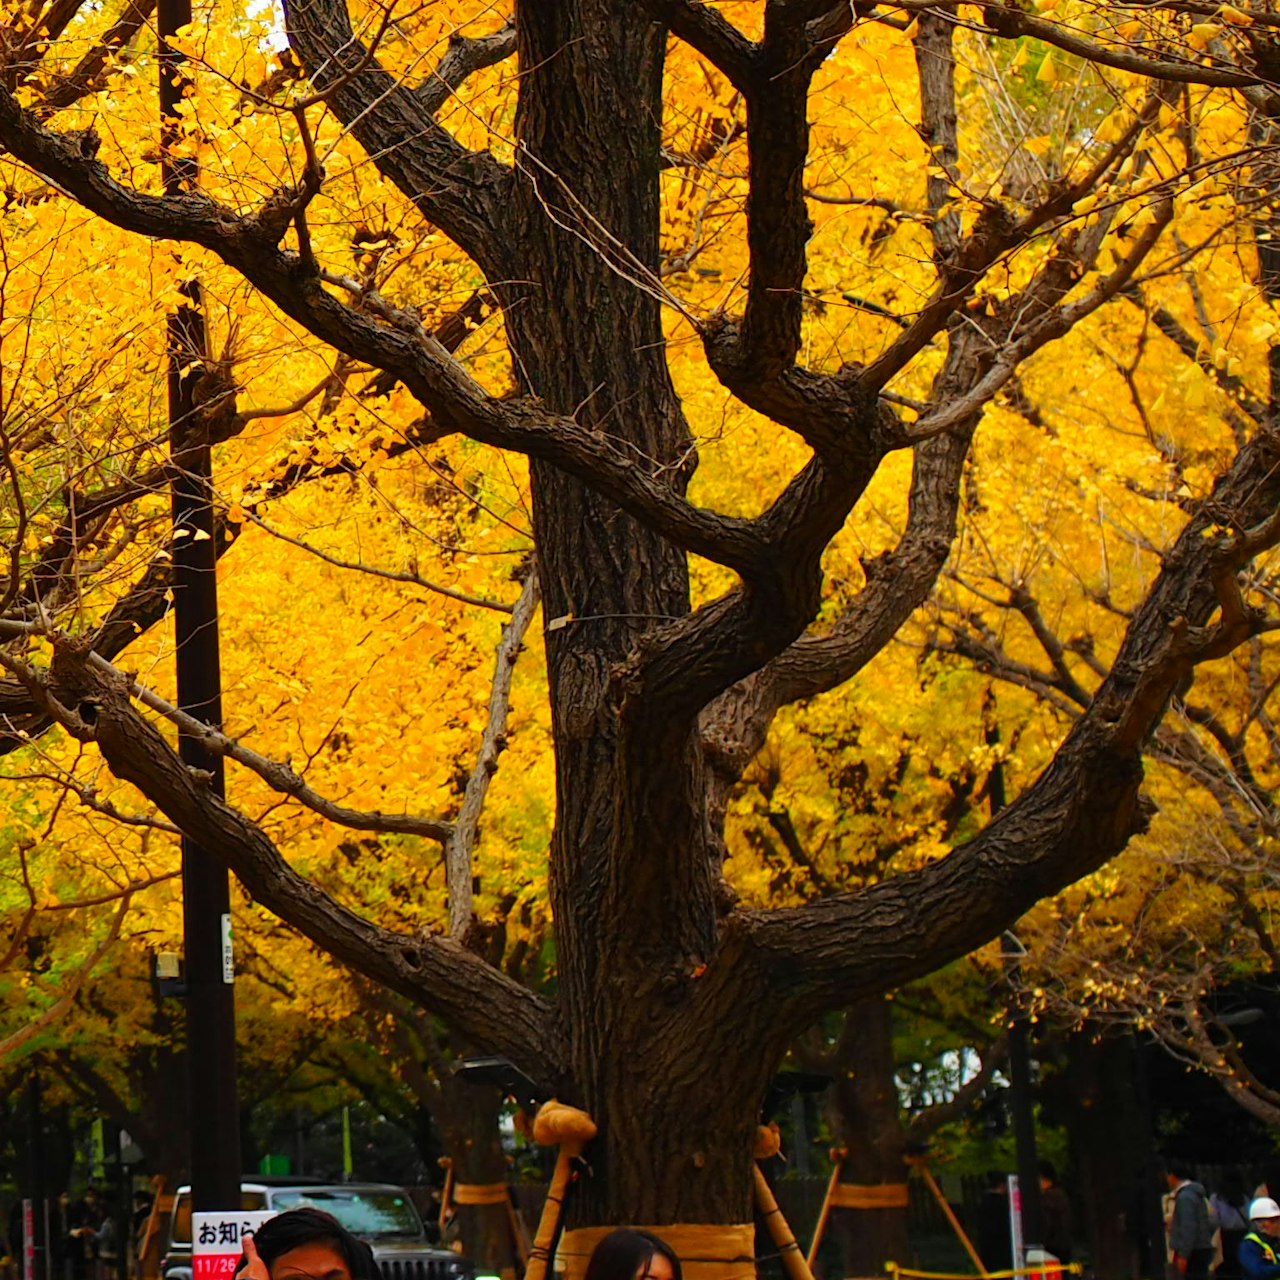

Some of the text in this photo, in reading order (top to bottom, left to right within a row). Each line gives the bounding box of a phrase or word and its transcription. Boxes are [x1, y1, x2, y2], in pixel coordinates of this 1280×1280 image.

[199, 1221, 264, 1244] お知ら
[197, 1258, 236, 1273] 11/26
